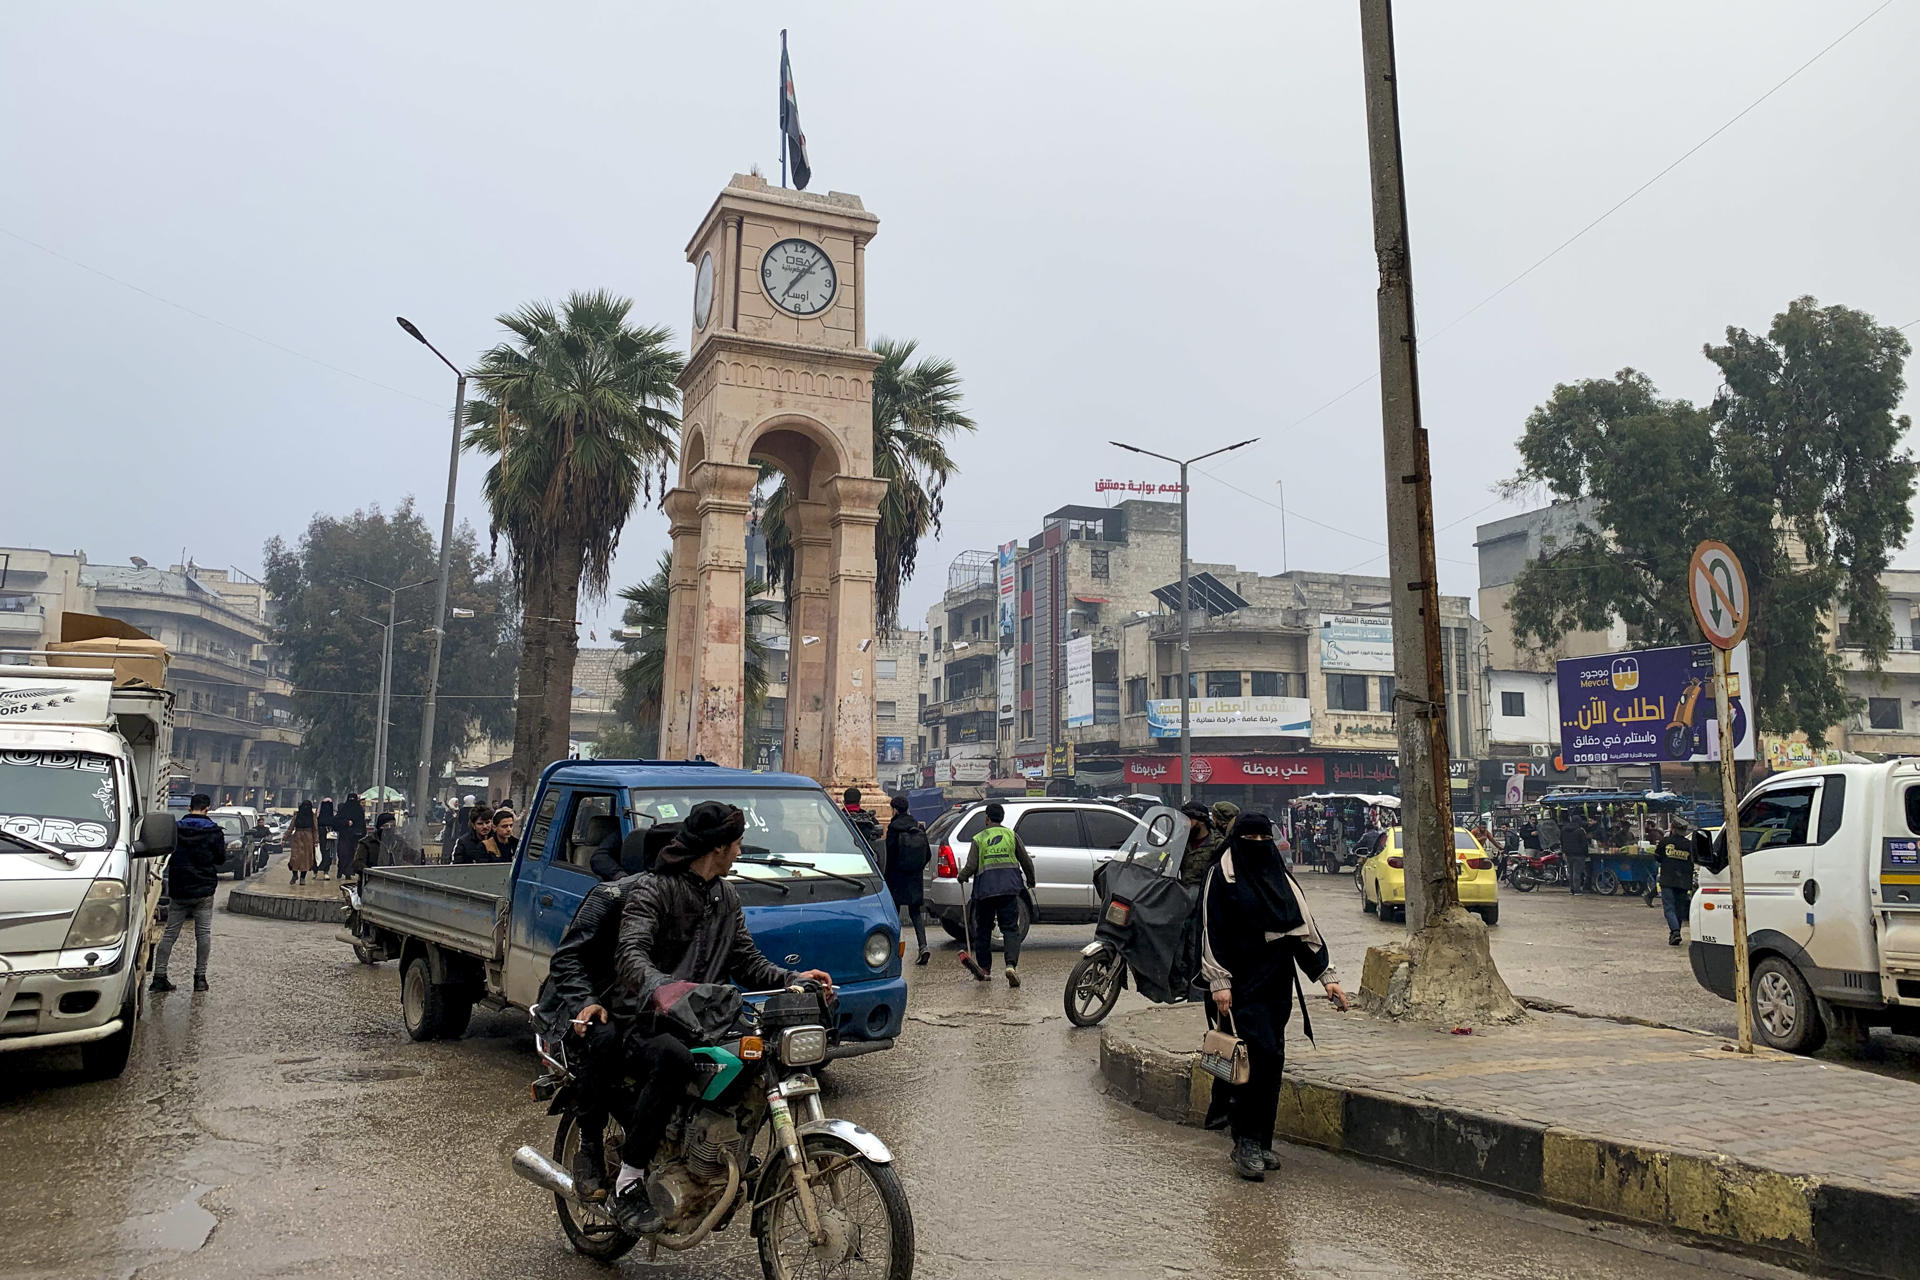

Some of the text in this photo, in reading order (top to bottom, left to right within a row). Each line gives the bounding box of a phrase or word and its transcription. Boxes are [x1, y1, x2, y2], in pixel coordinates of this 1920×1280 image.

[794, 244, 806, 254] 12
[786, 256, 811, 266] OSA
[764, 269, 772, 278] 9
[824, 279, 832, 288] 3
[794, 303, 800, 312] 6
[1095, 478, 1125, 492] دمشق
[1128, 480, 1155, 494] بوابة
[1580, 668, 1609, 678] موجود
[1580, 678, 1609, 688] Mevcut
[1206, 700, 1249, 713] العطاء
[1613, 695, 1664, 726] اطلب
[1196, 716, 1215, 724] نسائية
[1216, 716, 1236, 724] جراحة
[1259, 715, 1277, 724] جراحة
[1573, 731, 1656, 749] واستلم في دقائق
[1131, 762, 1167, 779] علي بوظة
[1242, 761, 1308, 780] علي بوظة
[1502, 762, 1546, 776] GSM
